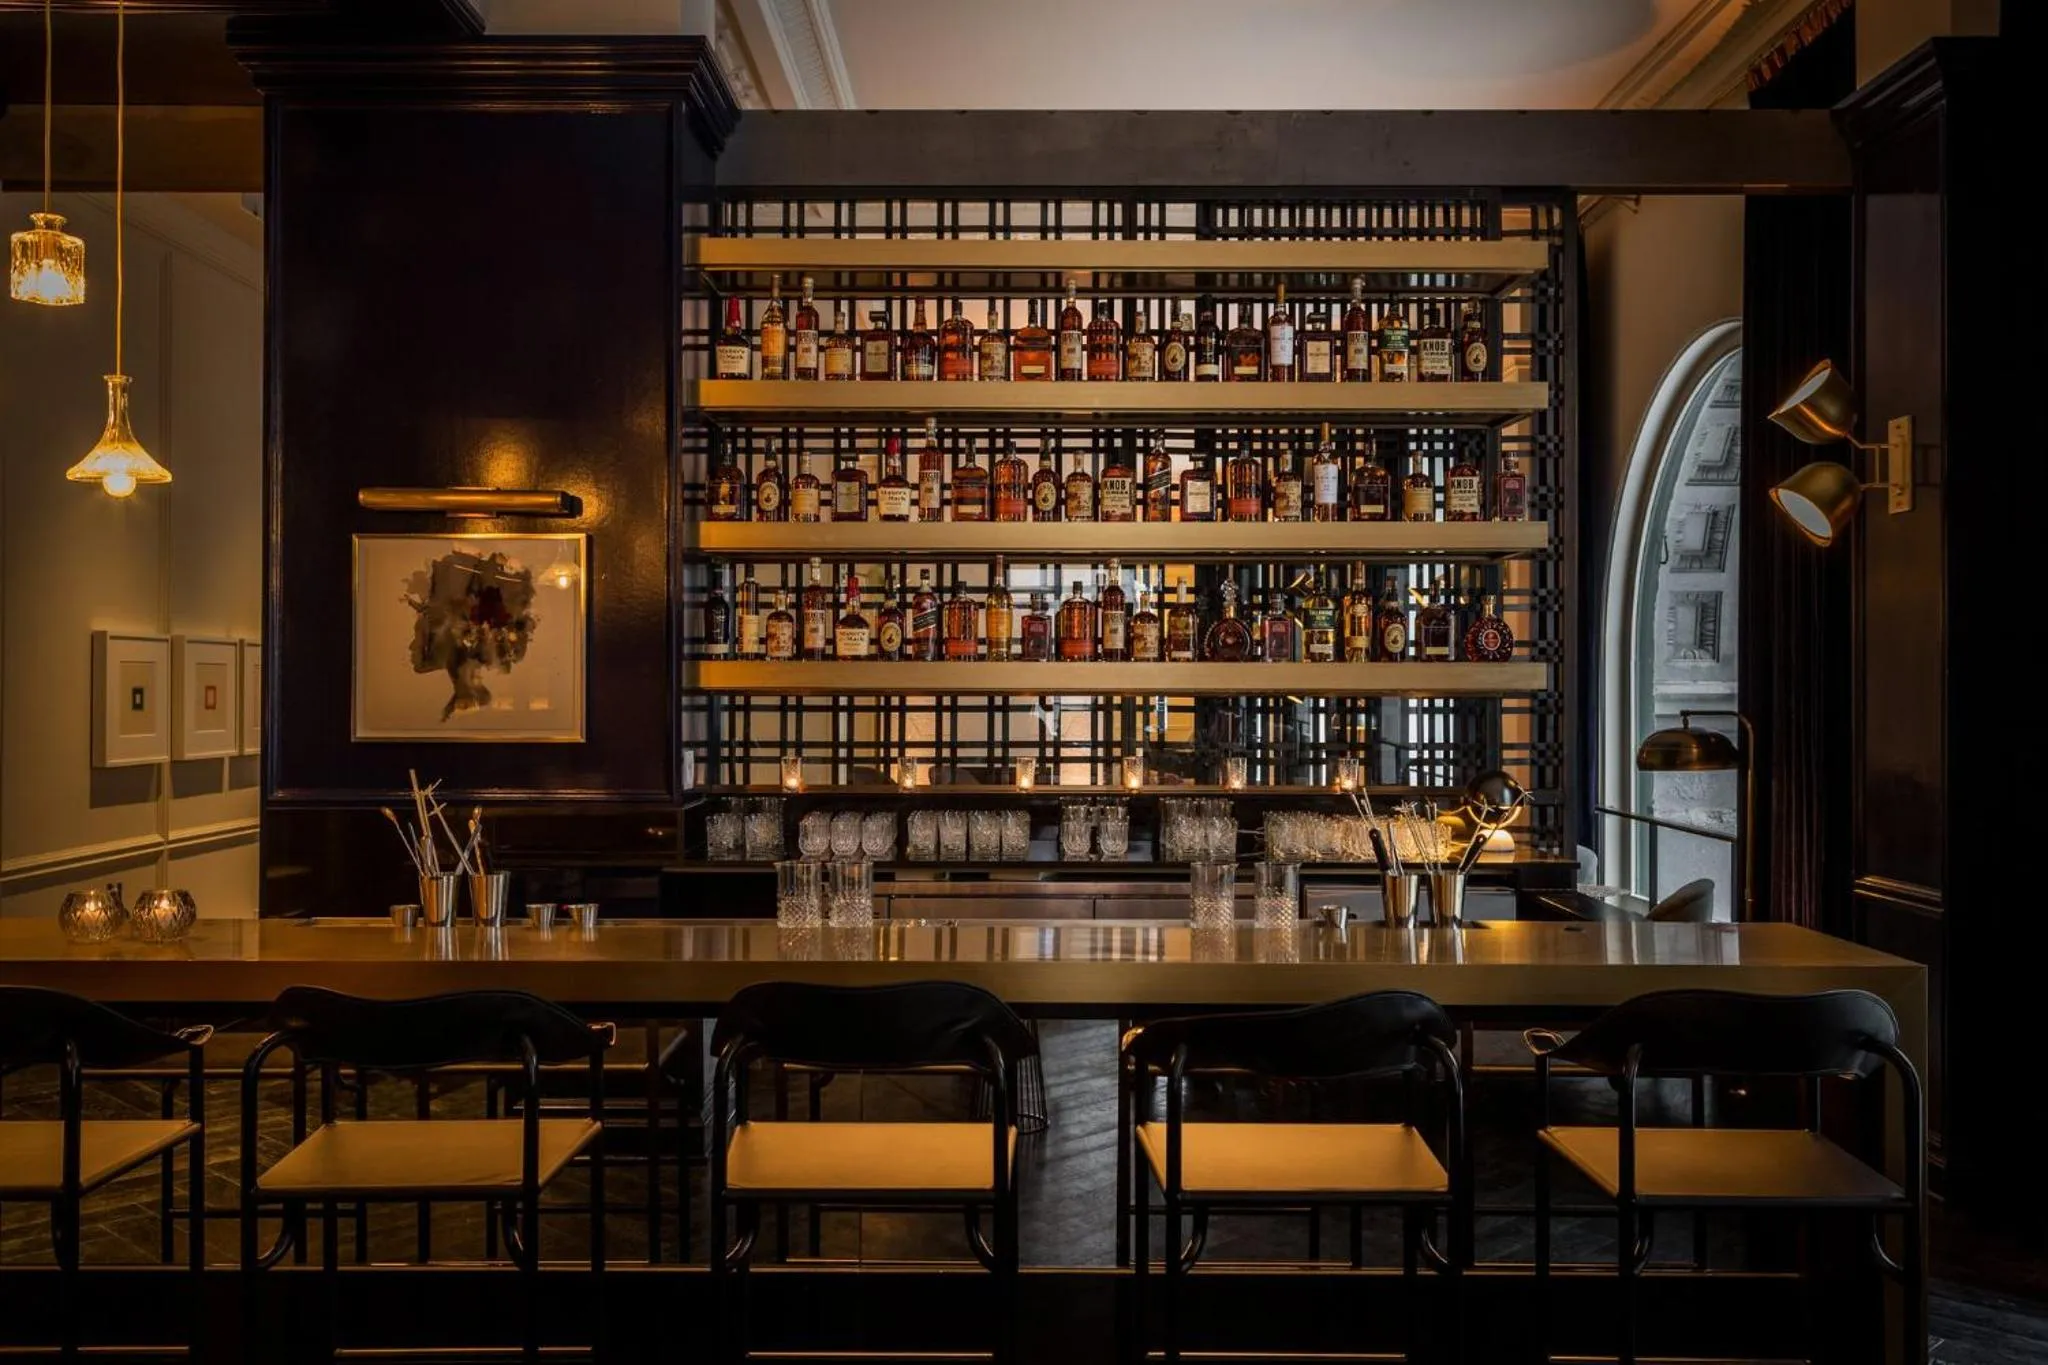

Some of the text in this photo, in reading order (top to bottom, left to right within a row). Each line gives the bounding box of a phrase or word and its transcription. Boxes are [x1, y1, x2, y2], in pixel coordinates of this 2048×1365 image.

[1423, 340, 1446, 352] KNOB
[1103, 480, 1126, 490] KNOB
[1450, 478, 1474, 490] KNOB
